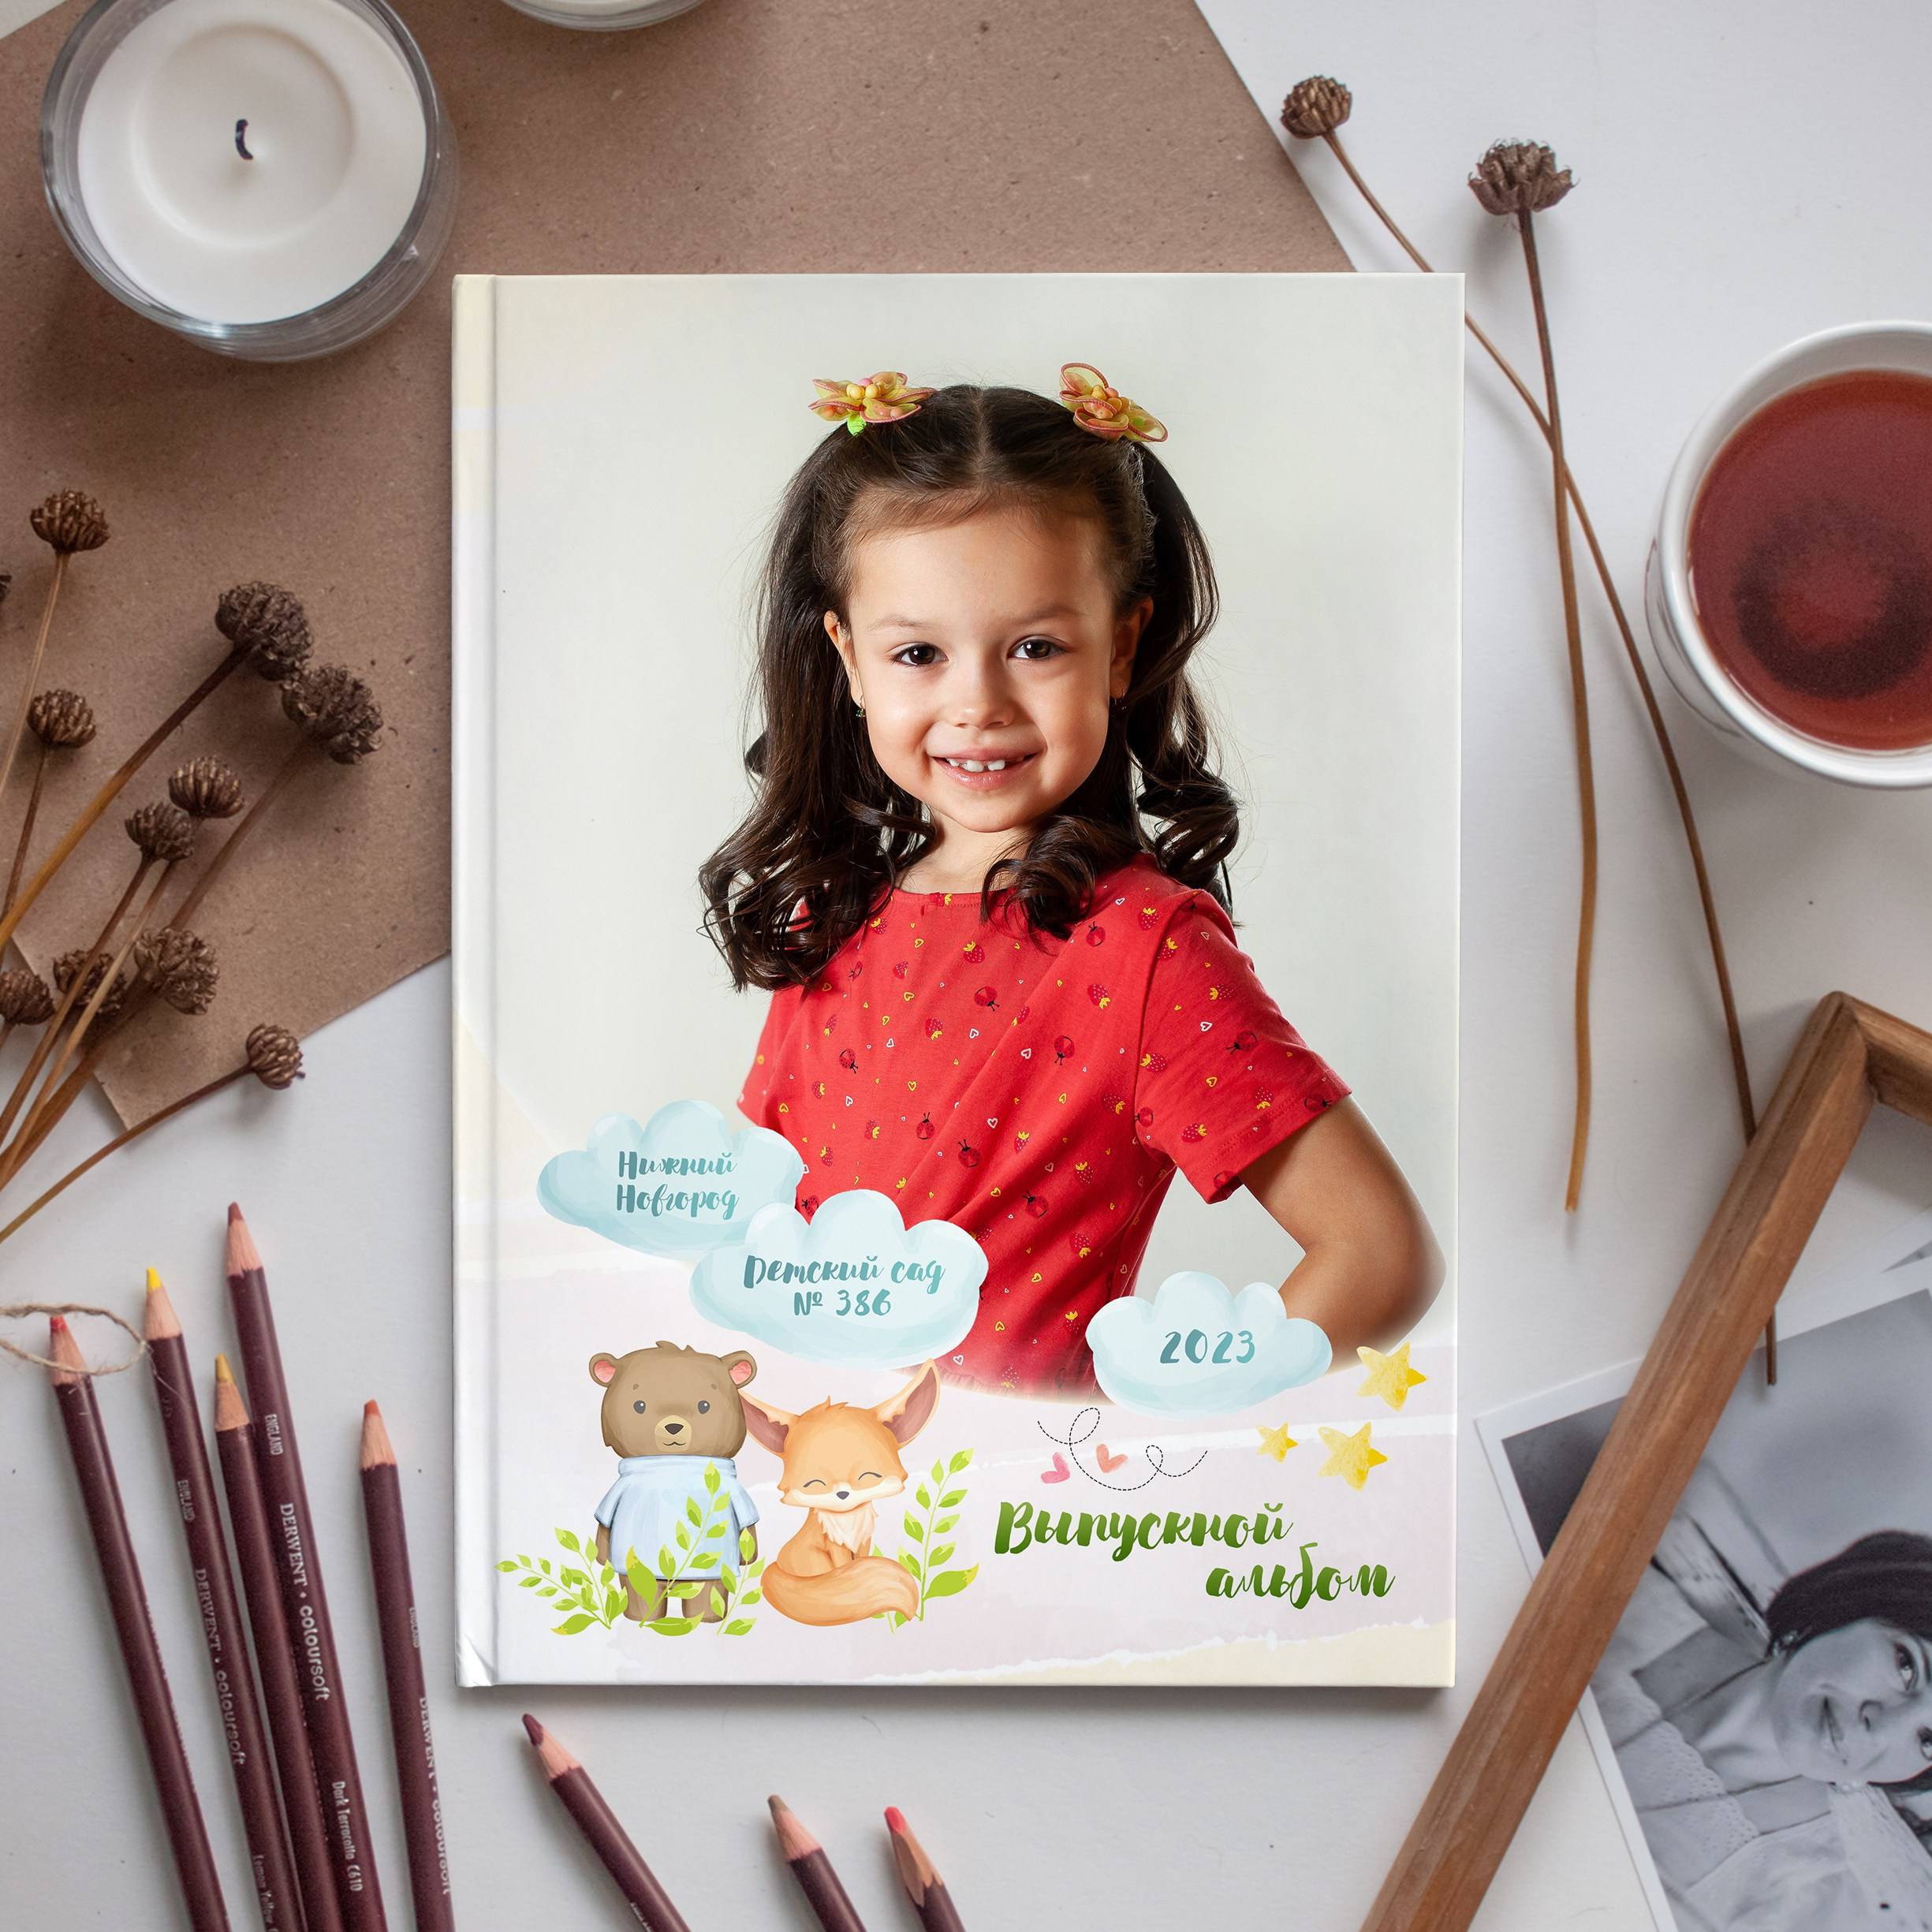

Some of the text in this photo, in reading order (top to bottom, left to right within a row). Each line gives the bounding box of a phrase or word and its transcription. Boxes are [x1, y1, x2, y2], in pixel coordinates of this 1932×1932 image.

[618, 1151, 737, 1180] Нижний
[616, 1184, 740, 1220] Новгород
[743, 1255, 946, 1294] Детский сад
[836, 1289, 892, 1316] 386
[1160, 1330, 1255, 1363] 2023
[265, 1414, 283, 1455] ENGLAND
[177, 1479, 195, 1522] ENGLAND
[994, 1501, 1293, 1561] Выпускной
[1206, 1542, 1396, 1609] альбом
[280, 1503, 330, 1699] DERWENT coloursoft
[196, 1568, 246, 1765] DERWENT coloursoft
[332, 1781, 363, 1892] Dark Terracotta C610
